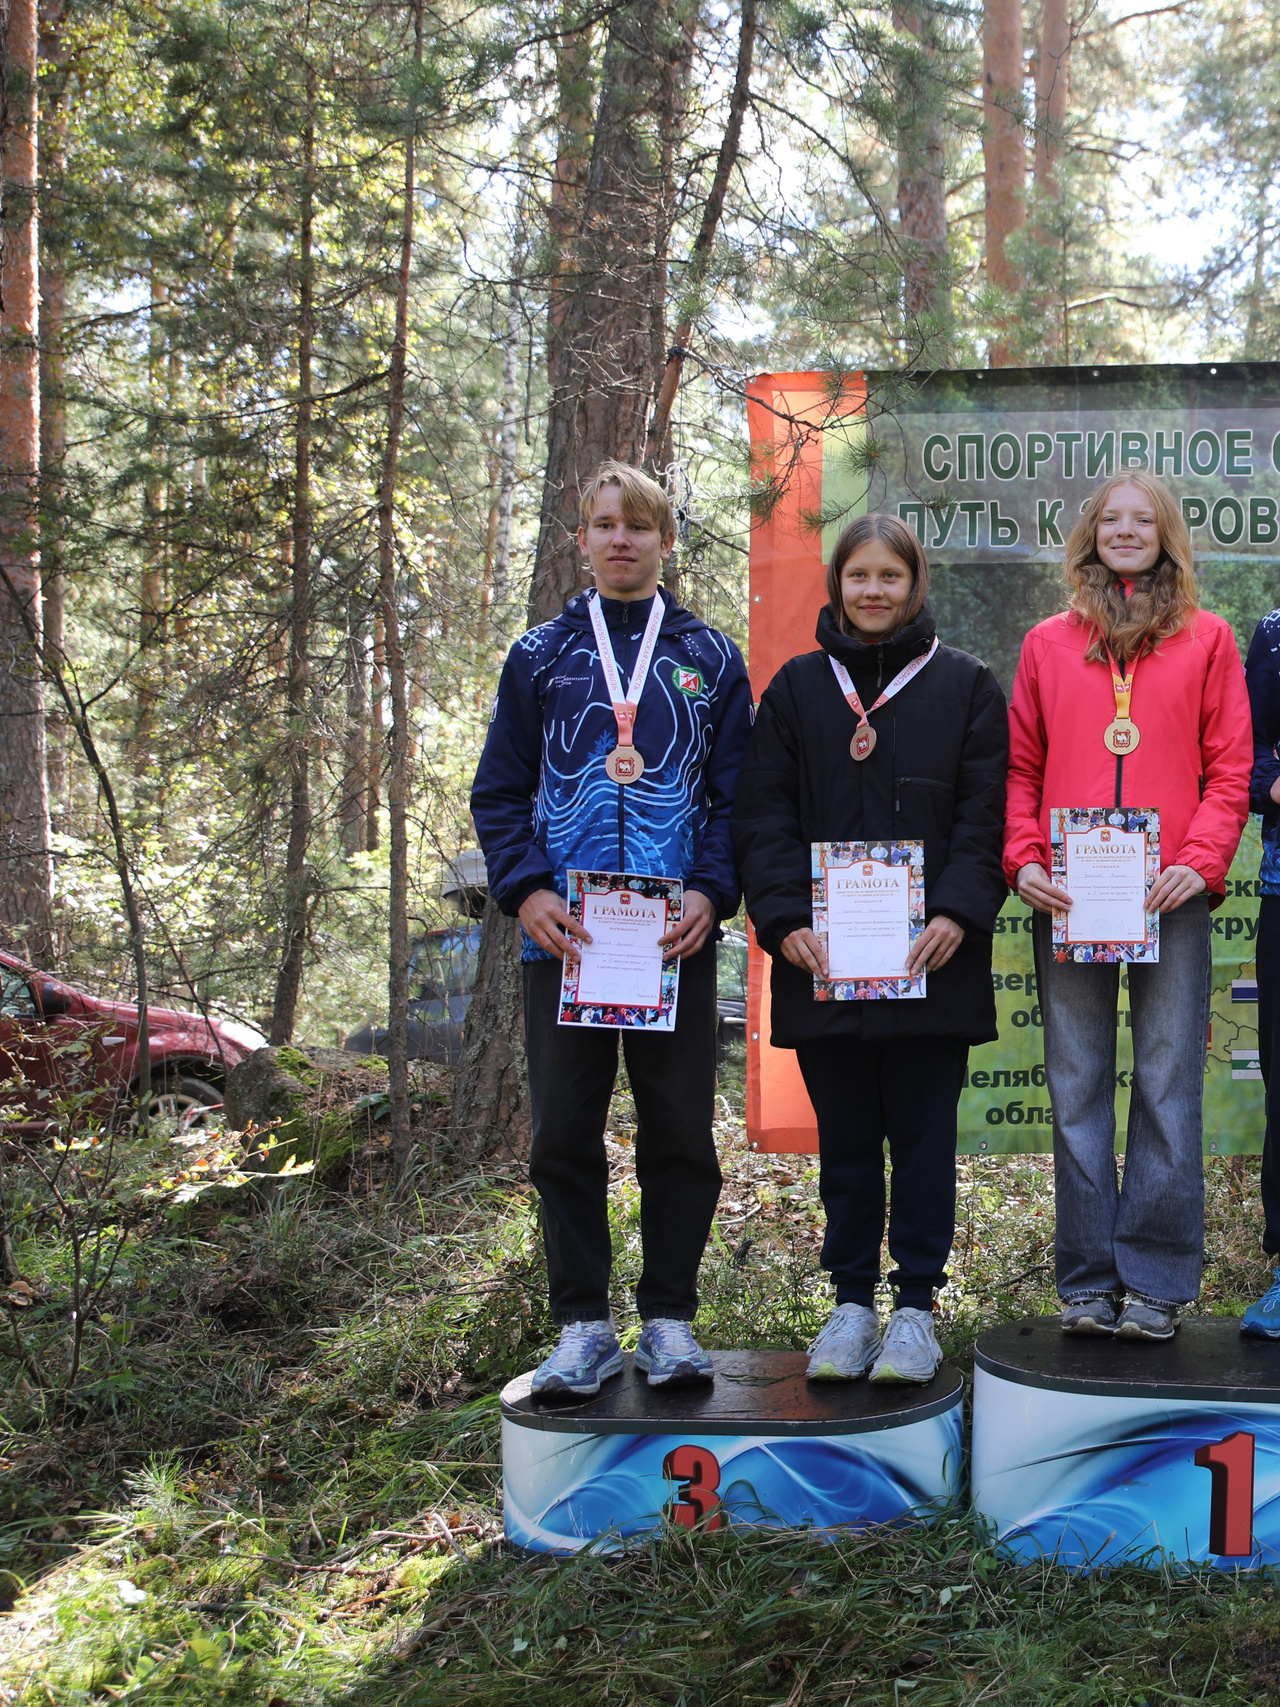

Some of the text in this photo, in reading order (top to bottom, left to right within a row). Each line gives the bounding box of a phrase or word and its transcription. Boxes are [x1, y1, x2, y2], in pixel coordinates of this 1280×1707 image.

[923, 427, 1253, 482] СПОРТИВНОЕ
[898, 500, 1020, 548] ПУТЬ
[1036, 498, 1066, 547] К
[1075, 844, 1137, 855] ГРАМОТА
[836, 878, 900, 889] ГРАМОТА
[593, 905, 656, 919] ГРАМОТА
[1210, 916, 1259, 941] кру
[662, 1445, 722, 1532] 3
[1195, 1432, 1256, 1556] 1
